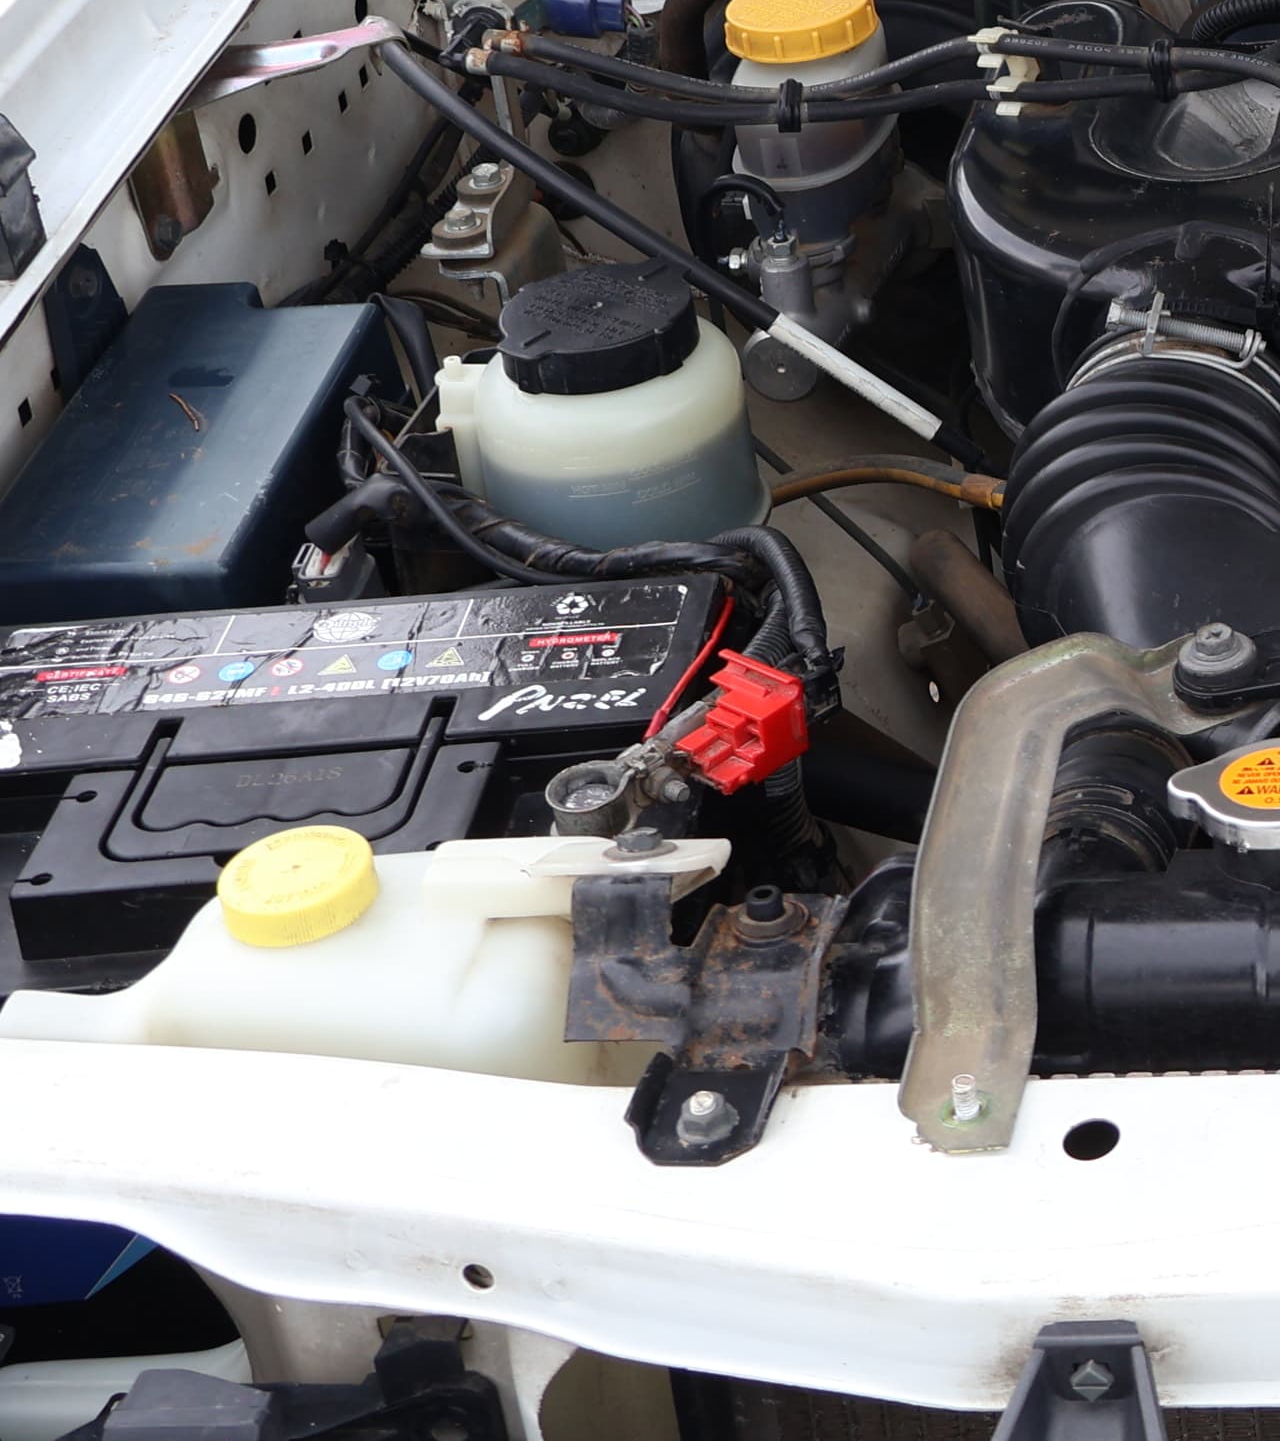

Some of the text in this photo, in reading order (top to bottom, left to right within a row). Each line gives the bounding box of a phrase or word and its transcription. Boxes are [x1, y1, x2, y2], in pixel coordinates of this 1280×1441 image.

[536, 633, 612, 646] HYDROMETER
[45, 667, 123, 680] CERTIFICATE
[46, 692, 93, 703] SABS
